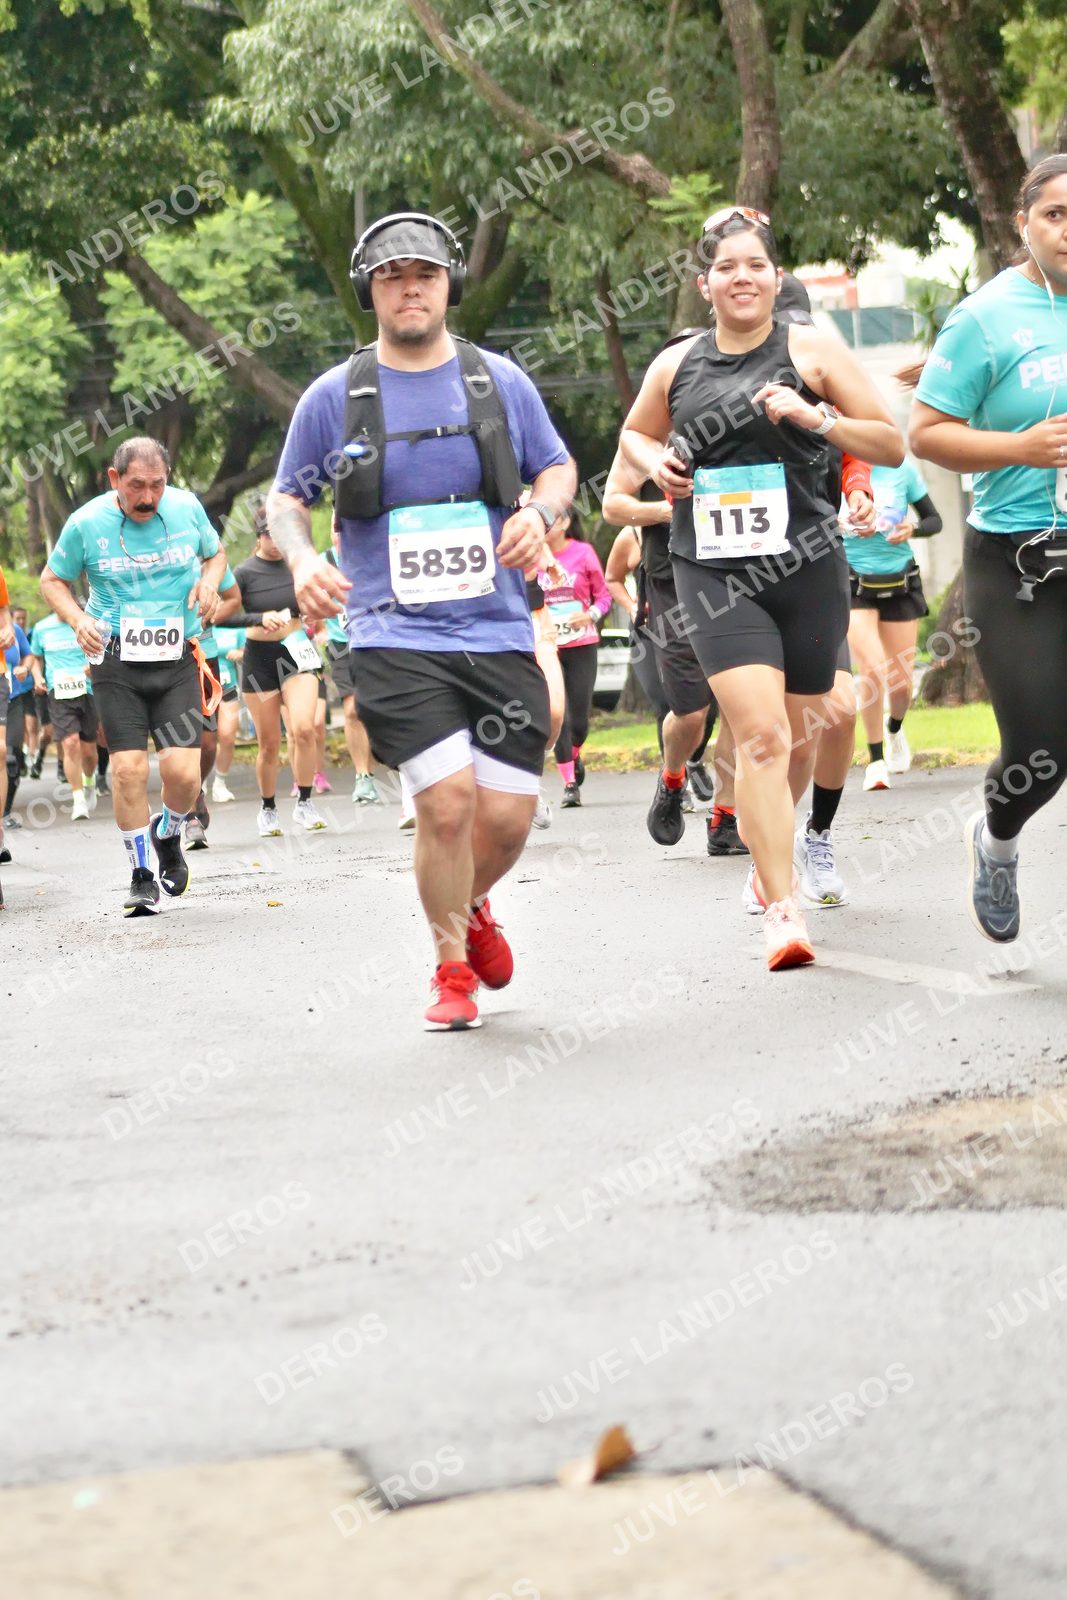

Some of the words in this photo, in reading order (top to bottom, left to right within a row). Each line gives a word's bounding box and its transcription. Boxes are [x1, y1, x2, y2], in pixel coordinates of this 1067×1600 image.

[709, 507, 771, 536] 113
[398, 544, 487, 579] 5839
[125, 628, 180, 647] 4060
